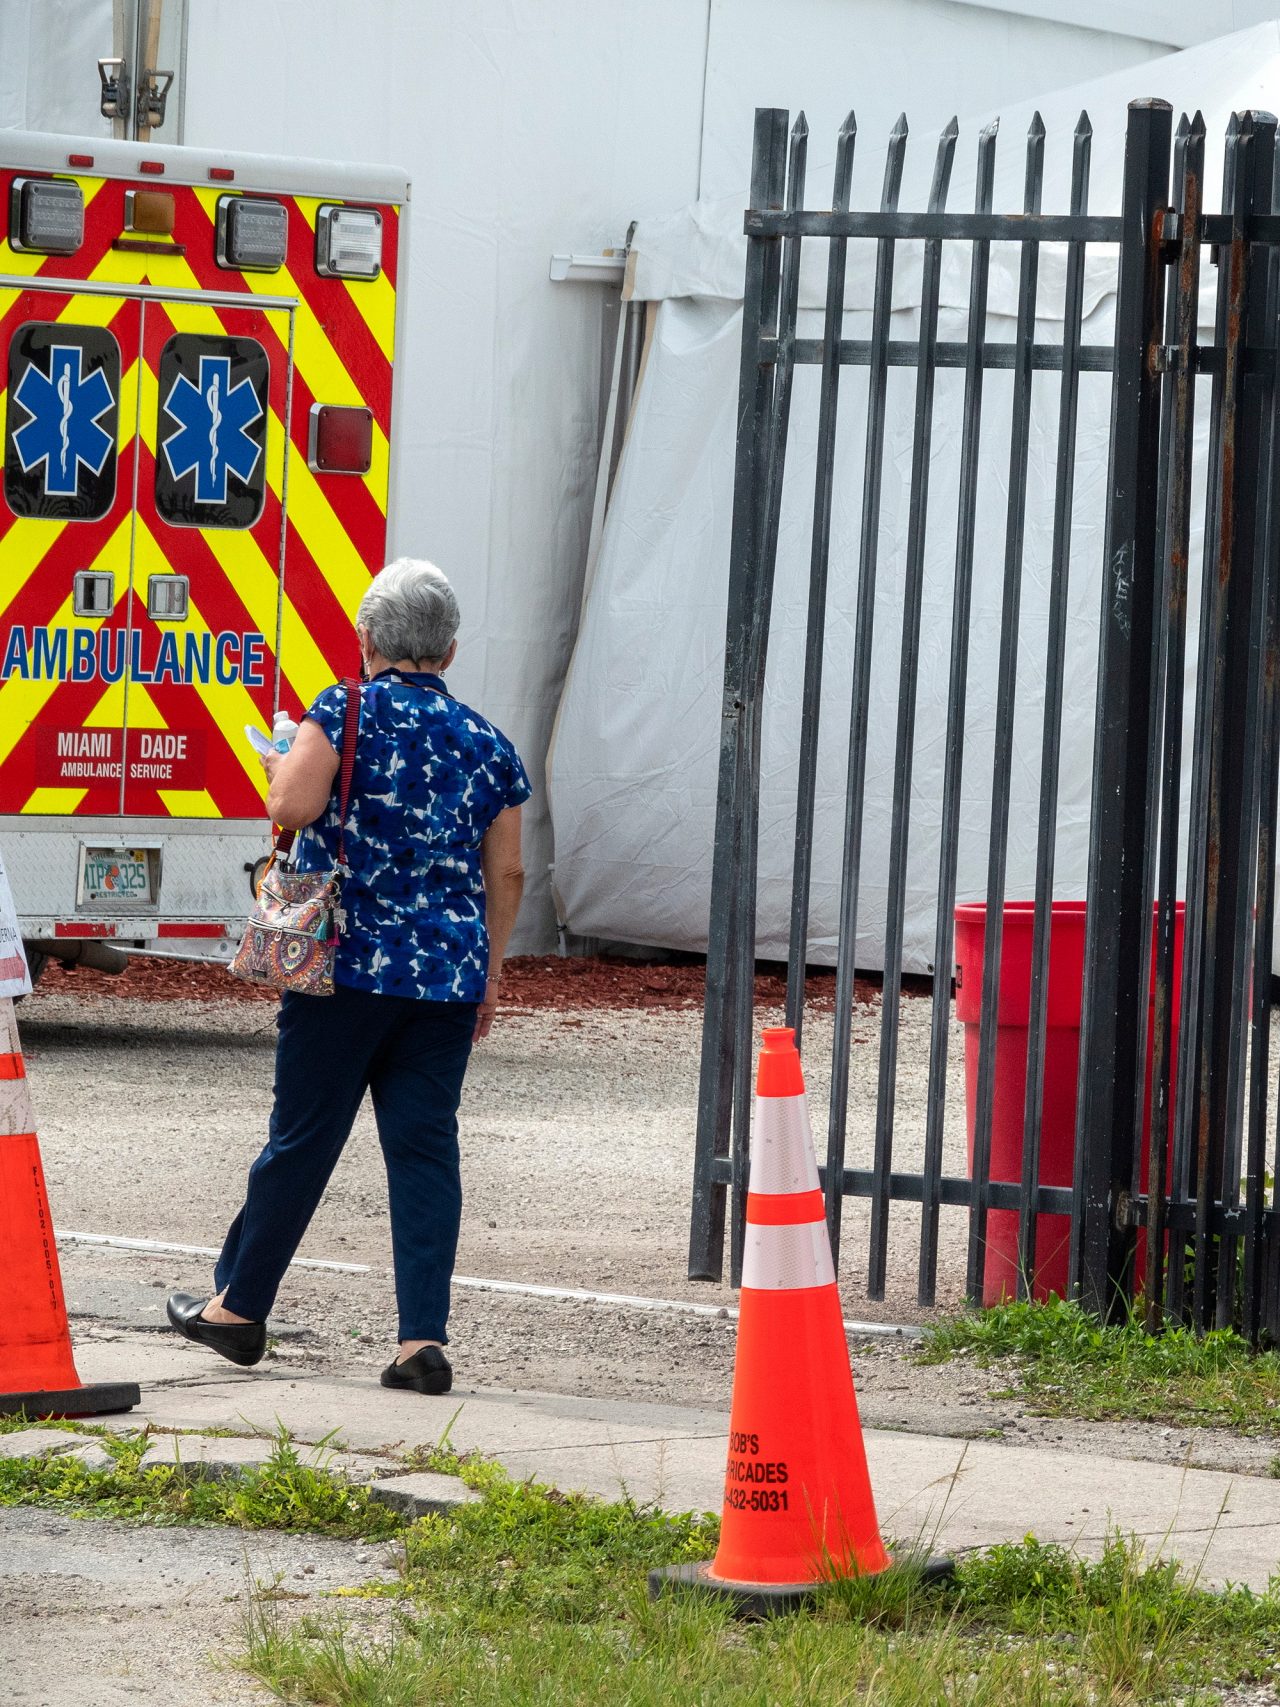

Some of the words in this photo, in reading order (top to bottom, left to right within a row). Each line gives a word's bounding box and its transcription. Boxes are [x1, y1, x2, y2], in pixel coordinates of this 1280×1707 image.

[1, 625, 265, 688] AMBULANCE
[57, 731, 112, 758] MIAMI
[140, 733, 188, 761] DADE
[60, 761, 122, 779] AMBULANCE
[130, 763, 173, 780] SERVICE
[120, 863, 146, 889] 325
[730, 1431, 760, 1456] BOB'S
[727, 1459, 789, 1484] RICADES
